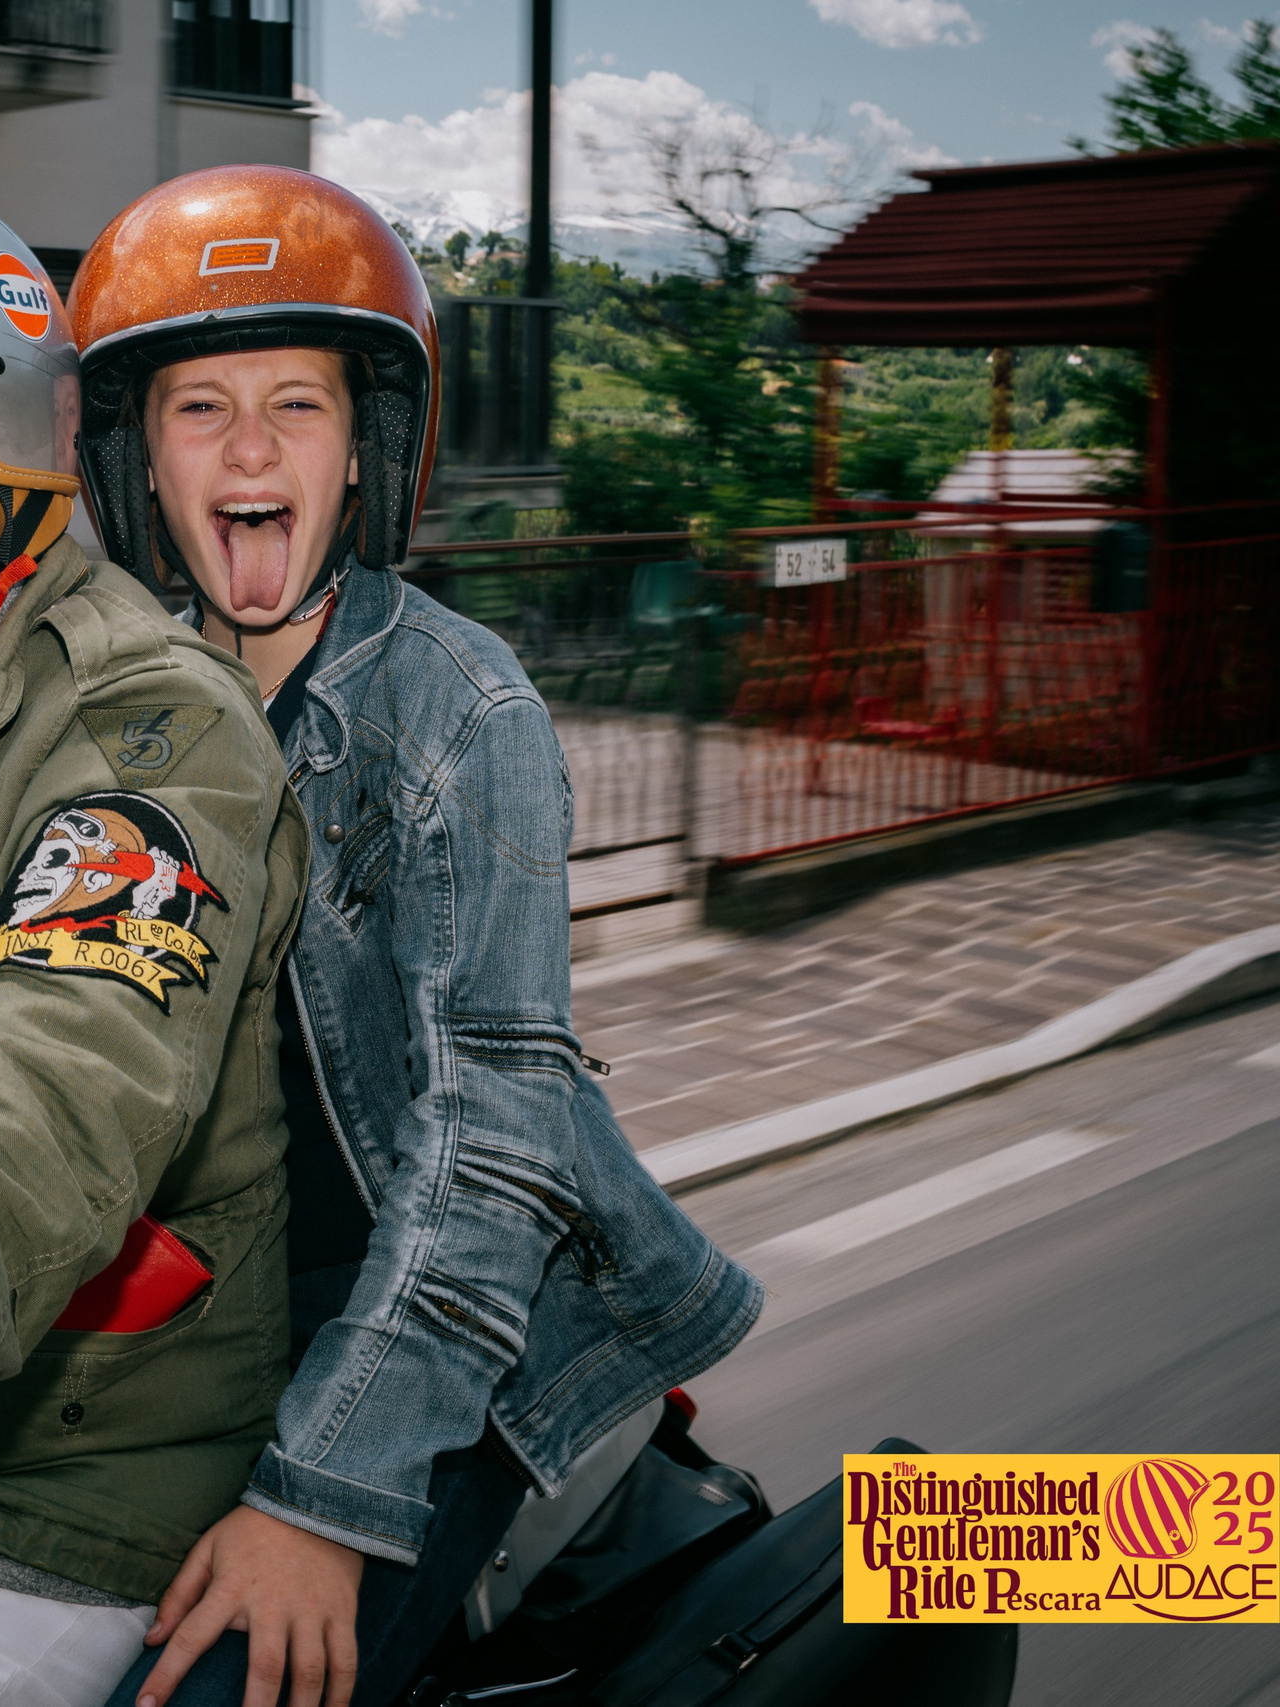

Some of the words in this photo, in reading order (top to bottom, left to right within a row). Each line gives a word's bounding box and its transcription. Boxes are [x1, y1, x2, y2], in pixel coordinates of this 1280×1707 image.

[787, 552, 802, 577] 52
[822, 549, 836, 573] 54
[3, 929, 58, 957] INST.
[125, 922, 149, 942] RL
